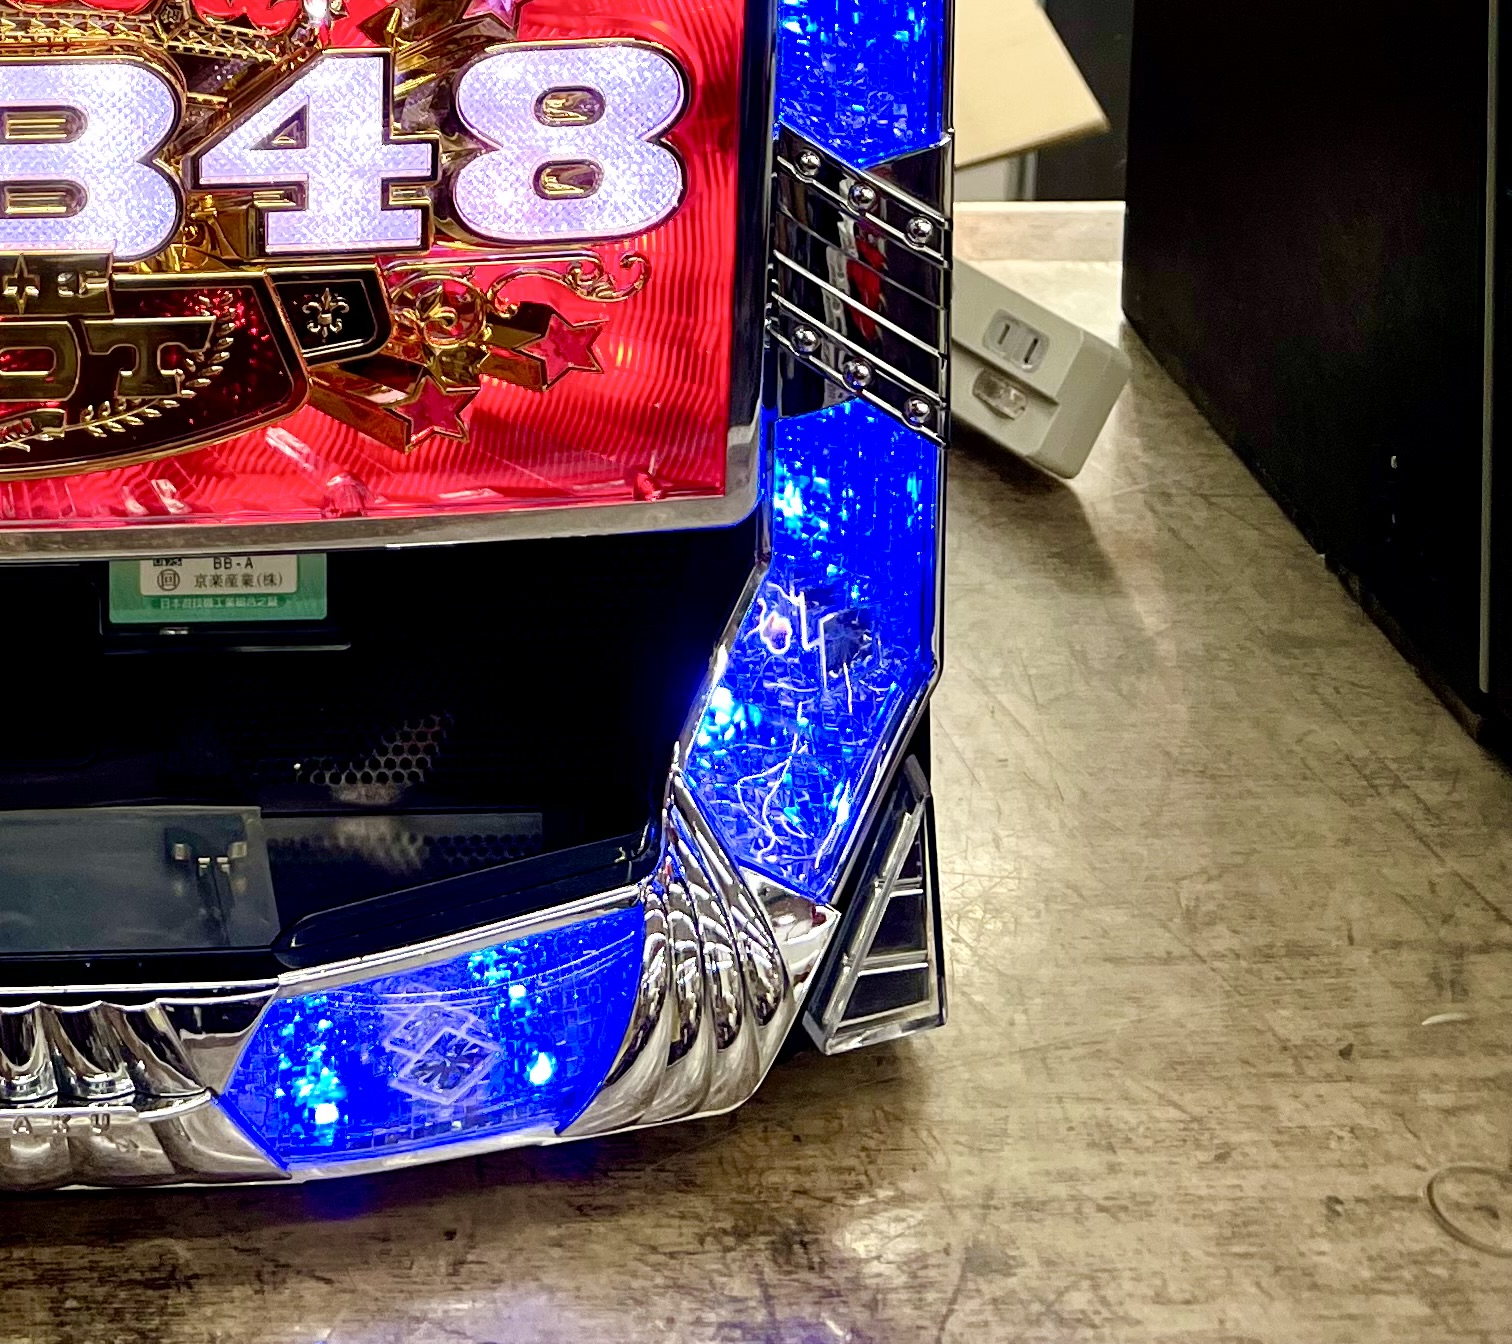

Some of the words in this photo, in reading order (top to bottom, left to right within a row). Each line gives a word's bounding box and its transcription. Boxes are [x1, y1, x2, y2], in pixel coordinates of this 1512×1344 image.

[194, 573, 284, 589] 京楽産業(株)
